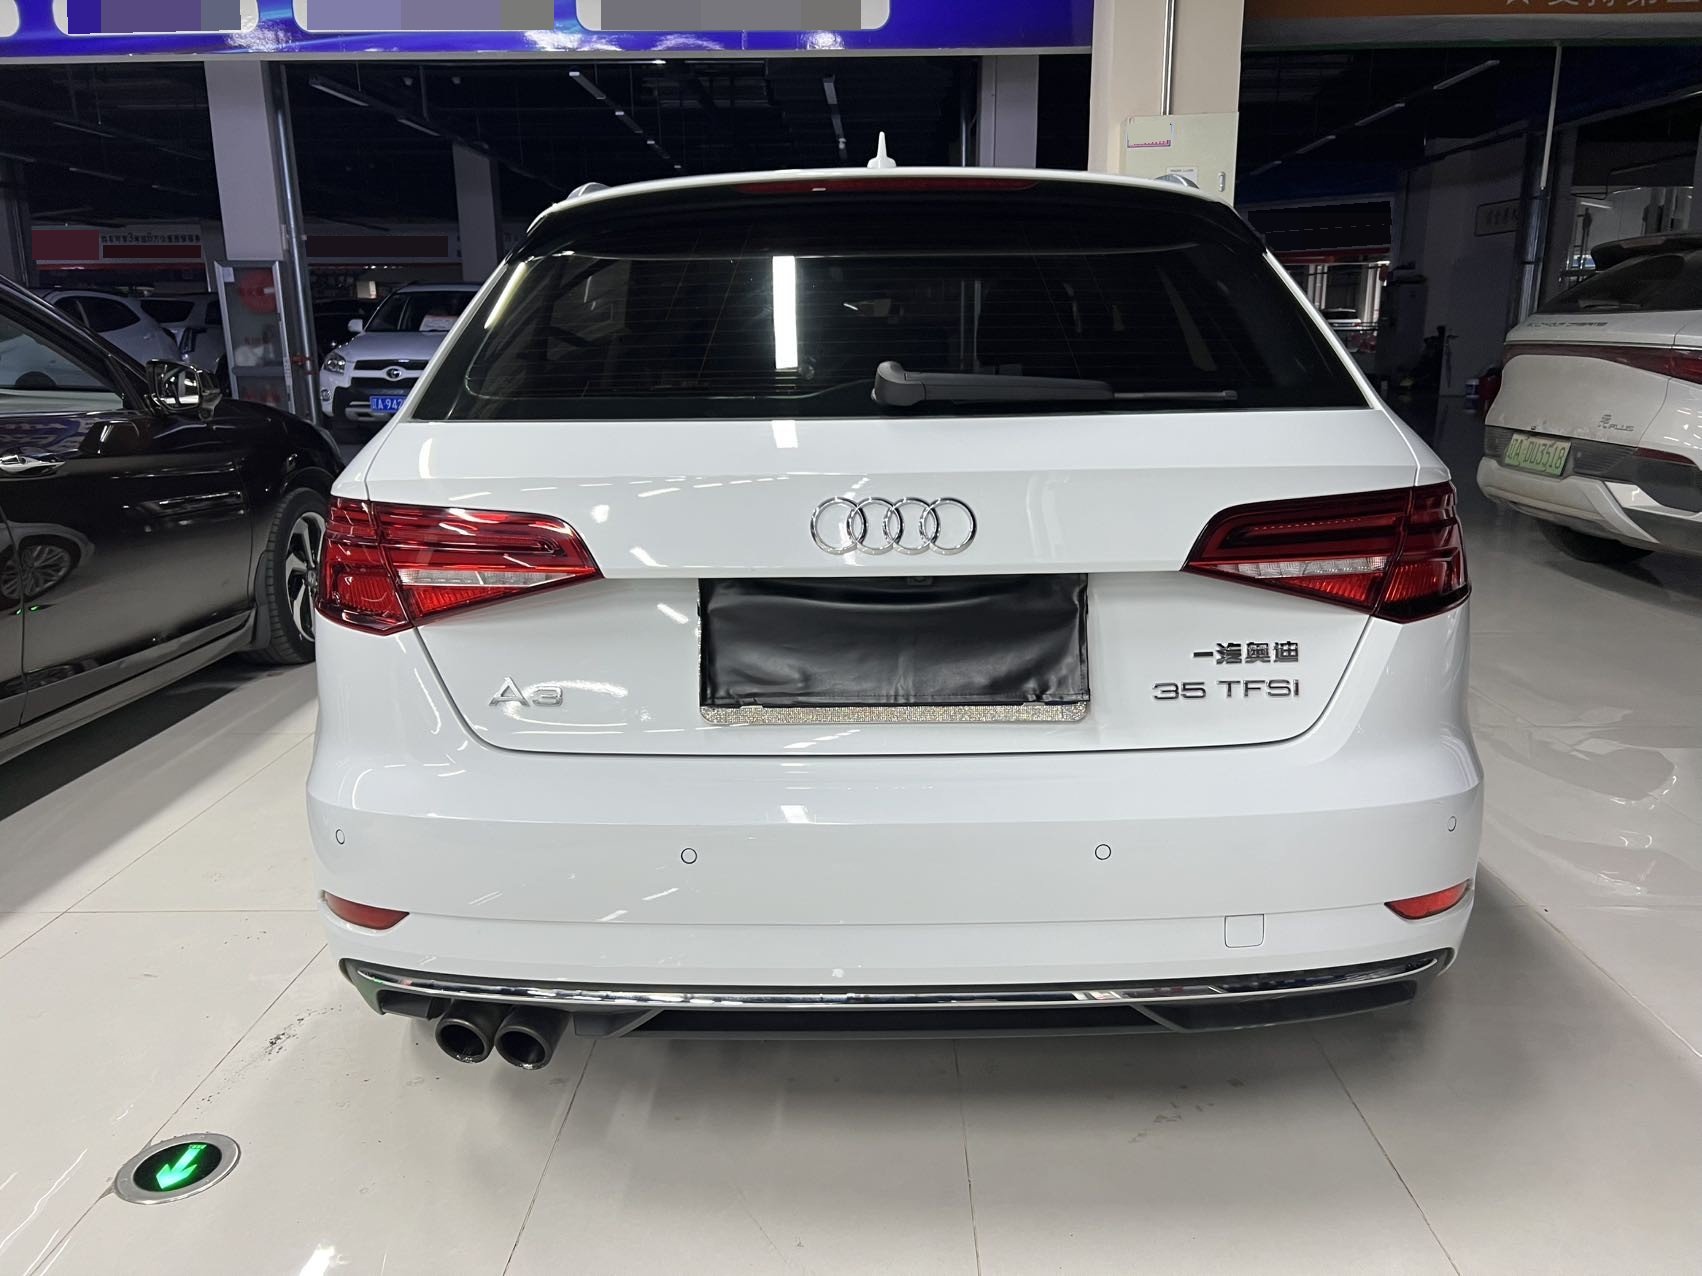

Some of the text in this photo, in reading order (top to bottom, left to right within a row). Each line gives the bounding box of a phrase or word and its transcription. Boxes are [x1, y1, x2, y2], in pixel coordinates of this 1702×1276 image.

[1193, 641, 1299, 664] 一汽奥迪
[489, 676, 563, 708] A3
[1152, 679, 1300, 699] 35 TFSI
